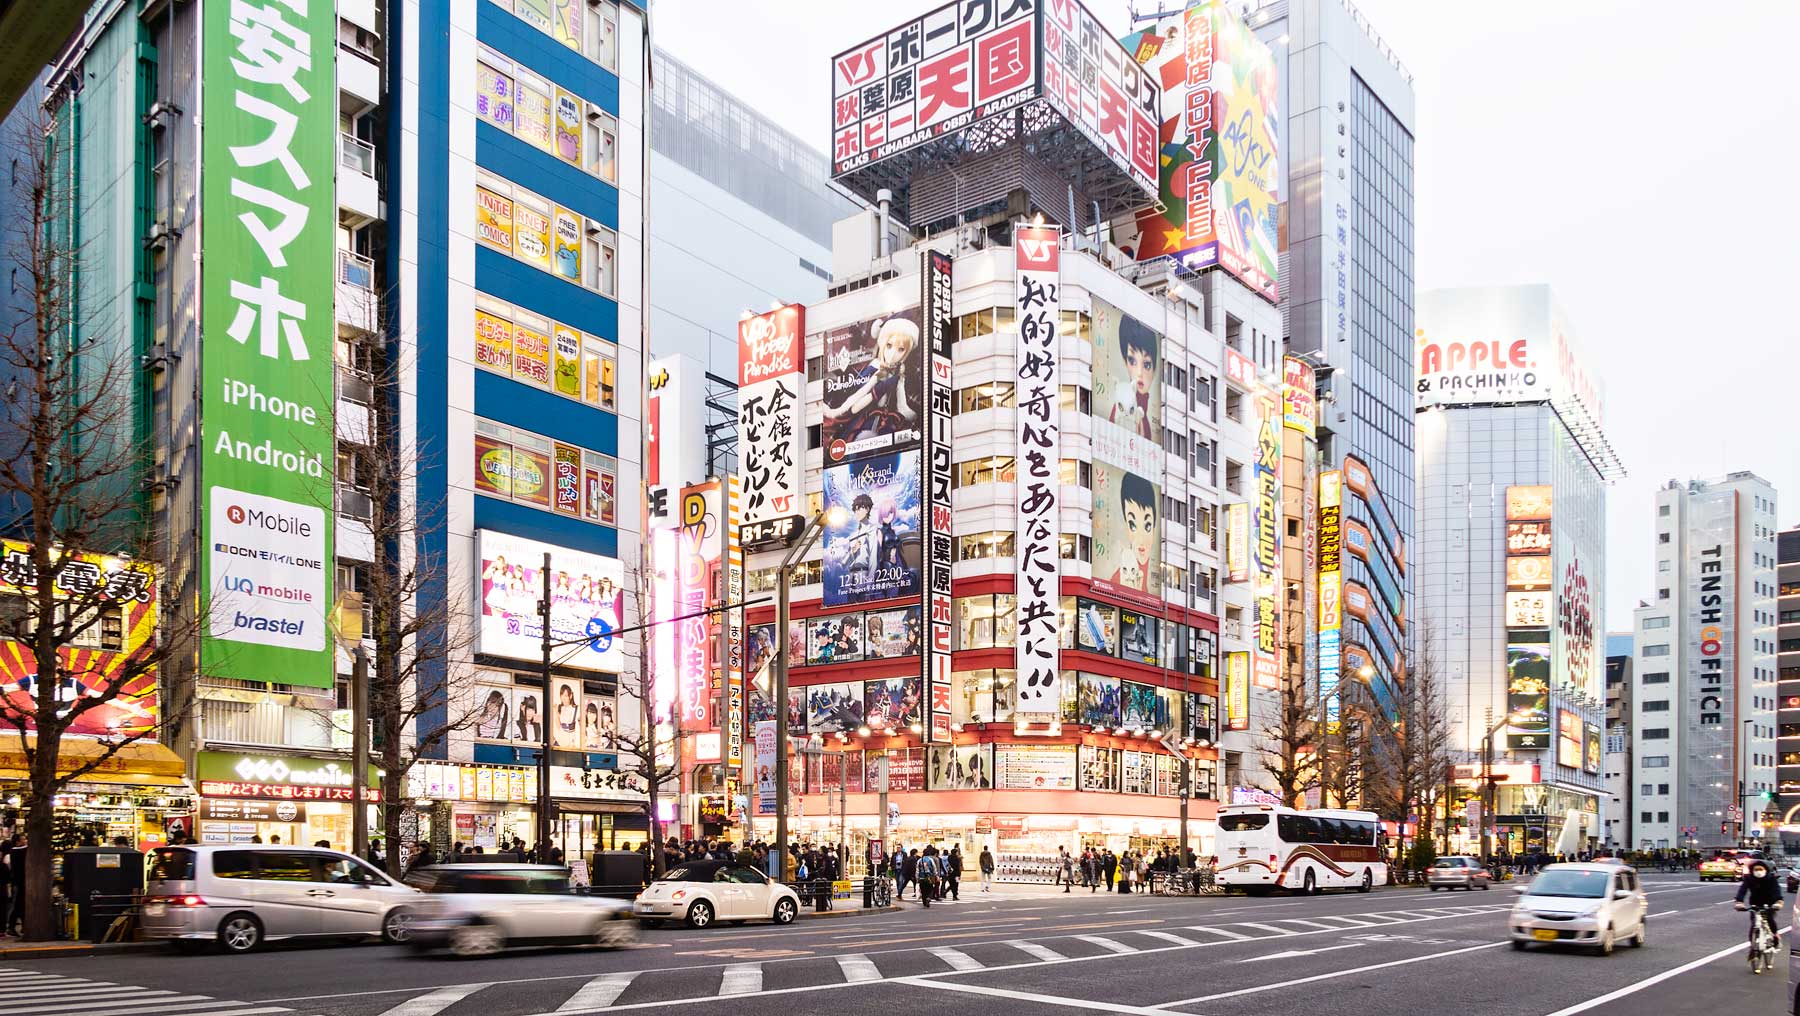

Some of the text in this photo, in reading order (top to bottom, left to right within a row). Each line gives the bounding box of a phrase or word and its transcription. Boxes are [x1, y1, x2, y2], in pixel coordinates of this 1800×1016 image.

[1045, 19, 1097, 95] 秋葉原
[1082, 19, 1158, 121] ボークス
[1185, 15, 1212, 88] 免税店
[836, 69, 914, 126] 秋葉原
[835, 90, 1036, 173] VOLKS AKIHABARA HOBBY PARADISE
[1186, 90, 1213, 160] DUTY
[226, 0, 311, 361] 安スマホ
[1186, 161, 1213, 240] FREE
[478, 223, 511, 248] COMICS
[558, 218, 577, 231] FREE
[933, 254, 942, 352] PARADISE
[942, 254, 951, 325] HOBBY
[476, 342, 548, 383] まんが喫茶
[477, 318, 548, 356] インターネット
[222, 378, 316, 426] iPhone
[1416, 372, 1537, 393] & PACHINKO
[214, 430, 322, 478] Android
[557, 463, 578, 504] ウェルカム
[1258, 396, 1277, 568] TAX FREE
[248, 509, 311, 538] Mobile
[224, 575, 313, 602] UQ mobile
[1322, 588, 1338, 625] DVD
[233, 611, 304, 636] brastel
[1701, 544, 1722, 726] TENSHO OFFICE
